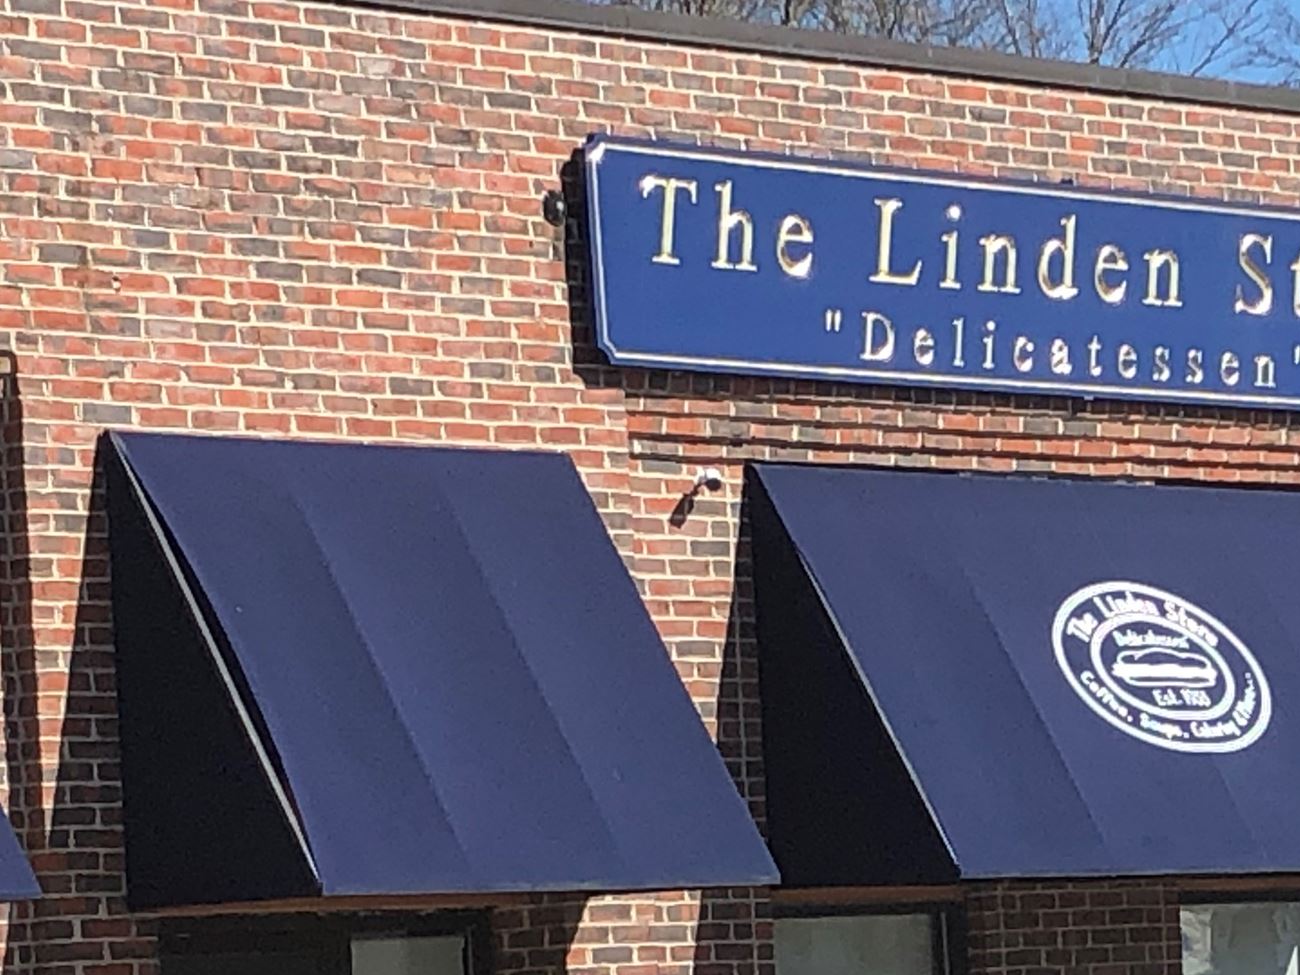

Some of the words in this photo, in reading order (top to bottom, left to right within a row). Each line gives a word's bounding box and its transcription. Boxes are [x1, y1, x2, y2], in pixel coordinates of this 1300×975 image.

[639, 172, 814, 279] The
[868, 198, 1183, 308] Linden
[1066, 613, 1099, 643] The
[1093, 591, 1160, 619] Linden
